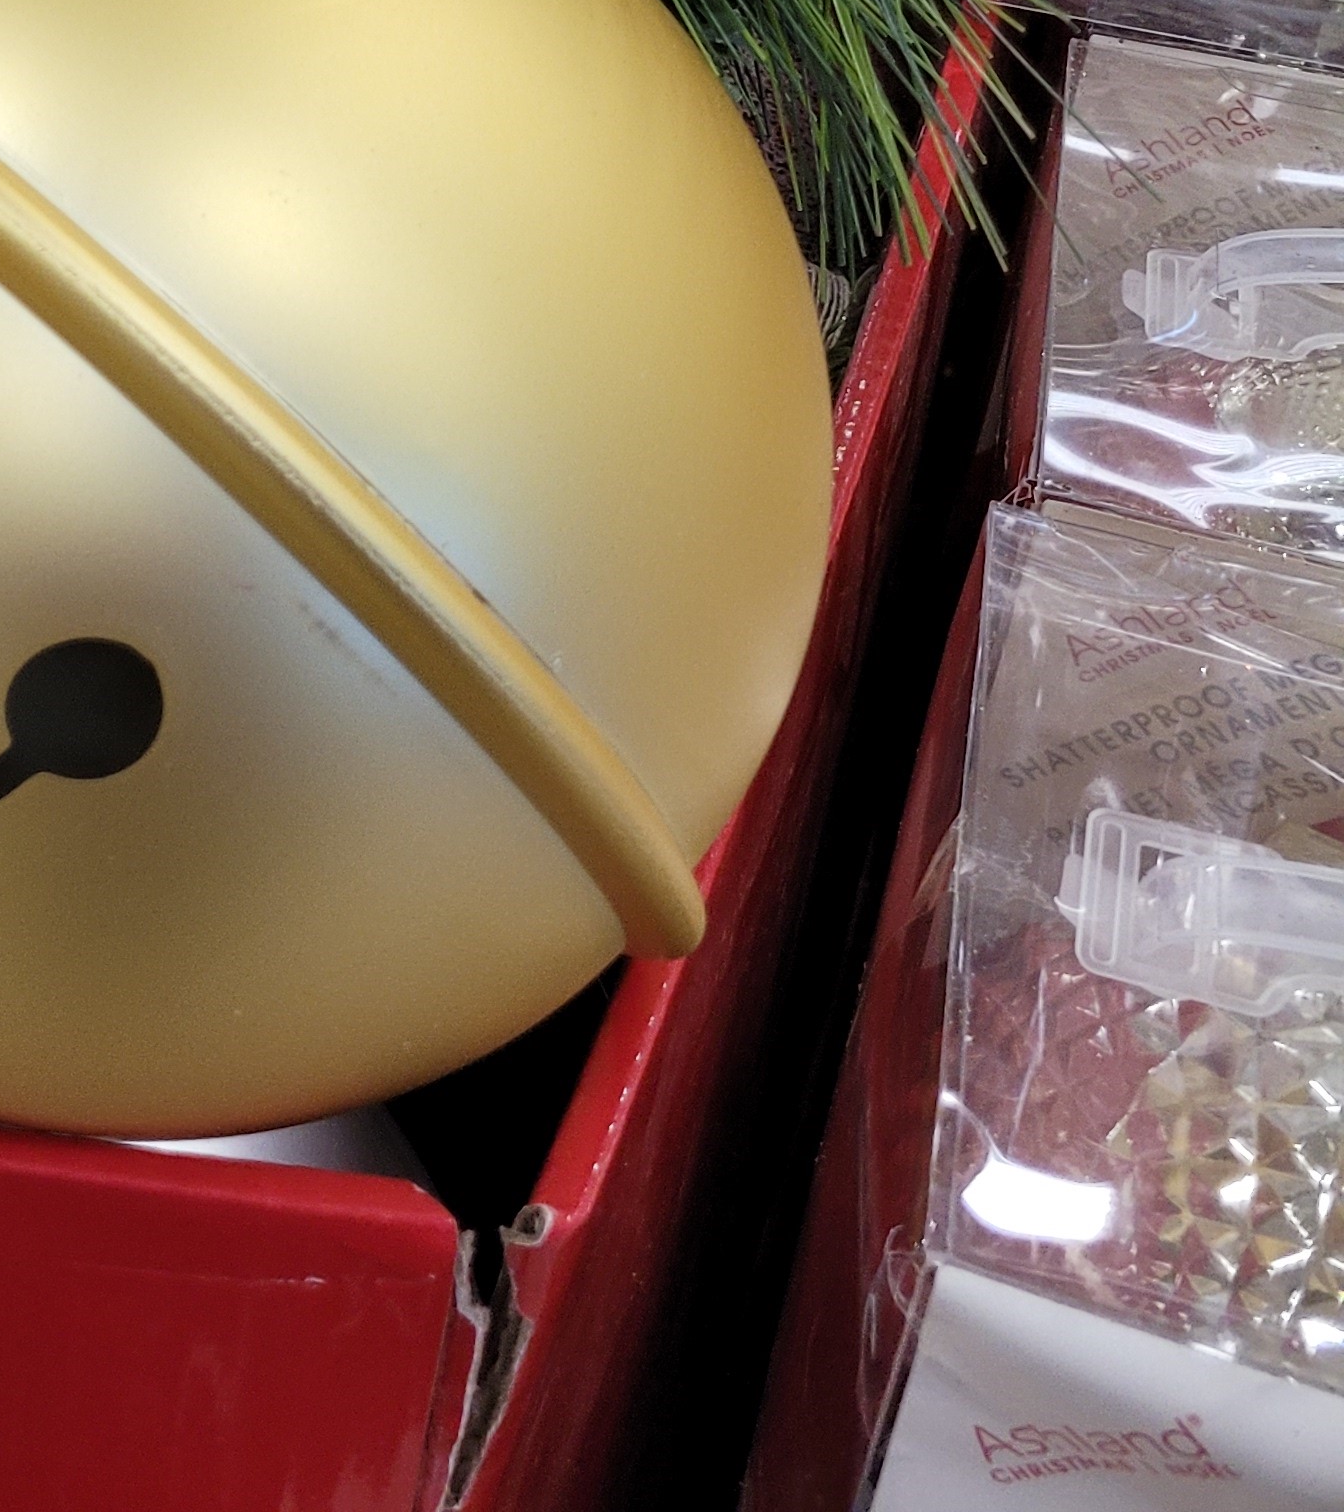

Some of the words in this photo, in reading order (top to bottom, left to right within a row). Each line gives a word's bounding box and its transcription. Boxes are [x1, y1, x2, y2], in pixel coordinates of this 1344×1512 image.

[1105, 99, 1259, 184] Ashland
[1114, 149, 1209, 199] CHISTMAS
[1066, 576, 1254, 667] Ashland
[1078, 630, 1194, 683] CHRISTMAS
[999, 676, 1249, 789] SHATTERPROOF
